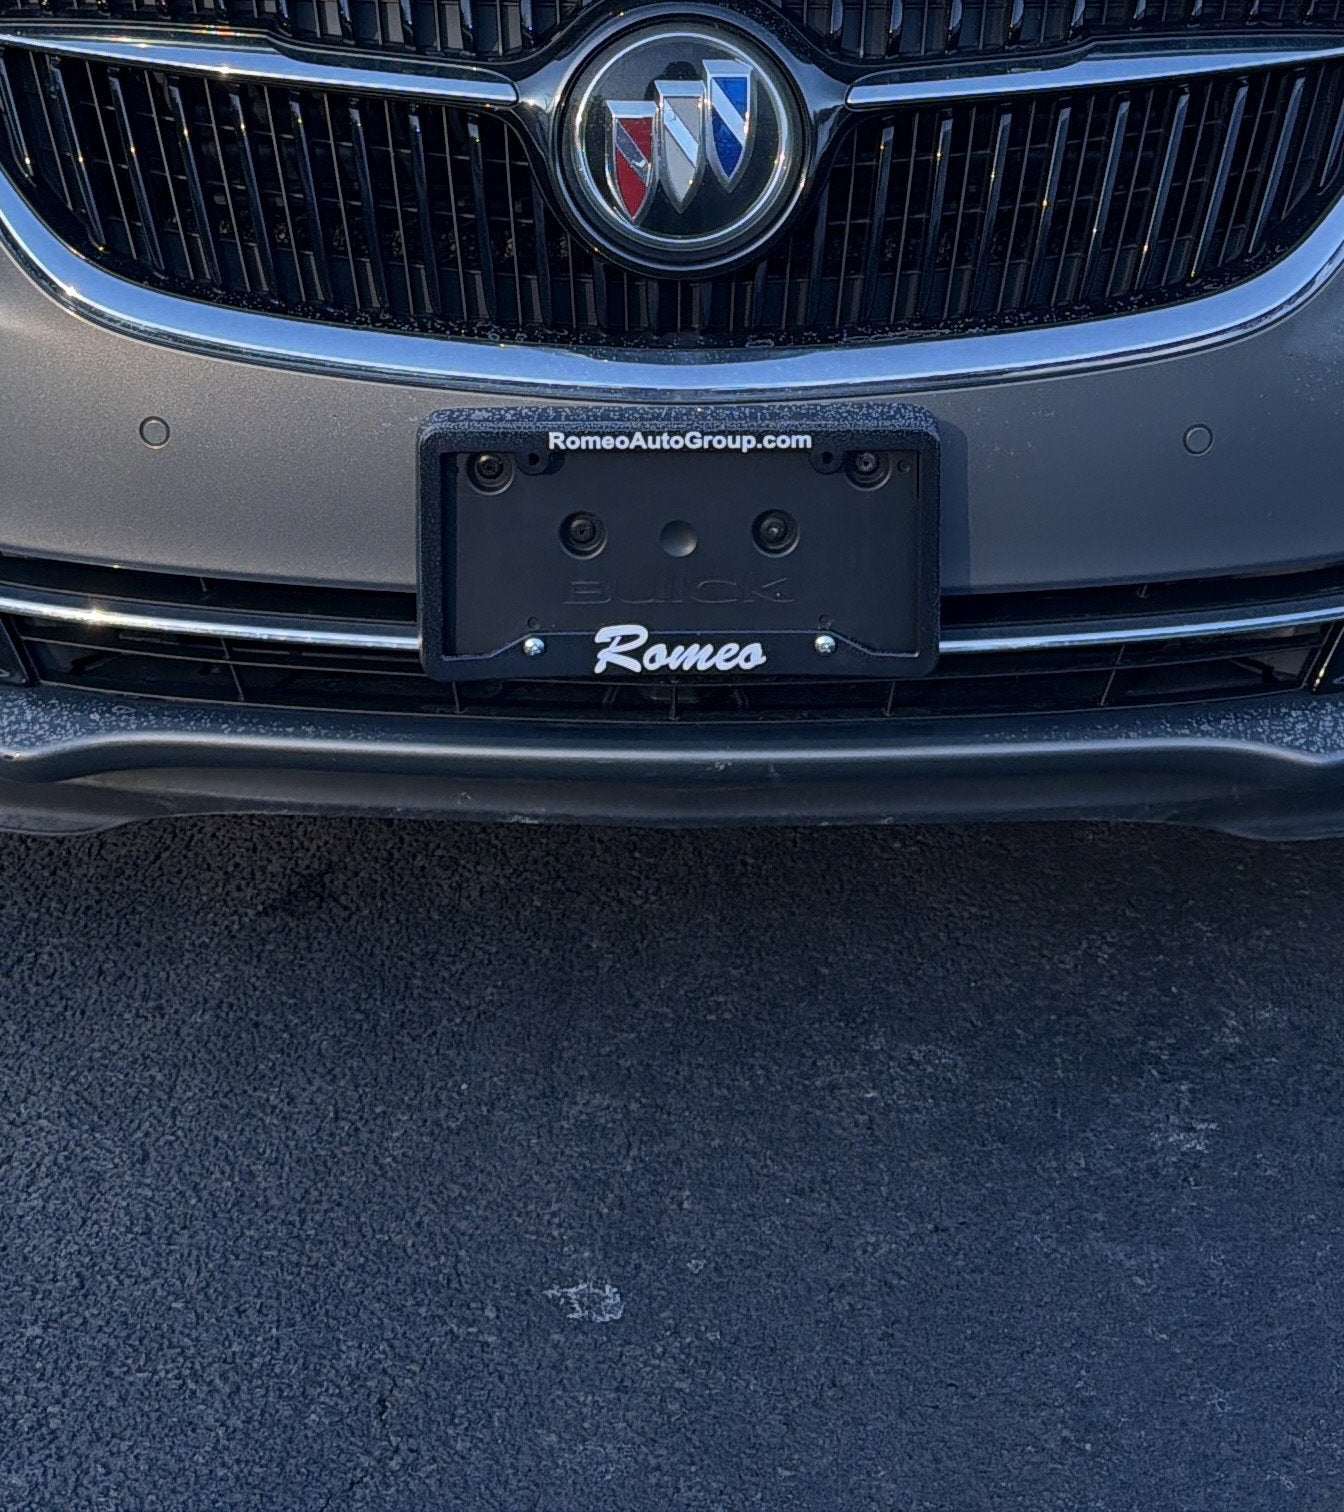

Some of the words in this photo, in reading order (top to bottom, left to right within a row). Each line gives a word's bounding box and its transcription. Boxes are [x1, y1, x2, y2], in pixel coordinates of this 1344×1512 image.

[548, 431, 812, 453] RomeoAutoGroup.com
[563, 577, 795, 605] BUICK
[594, 624, 767, 674] Romeo
